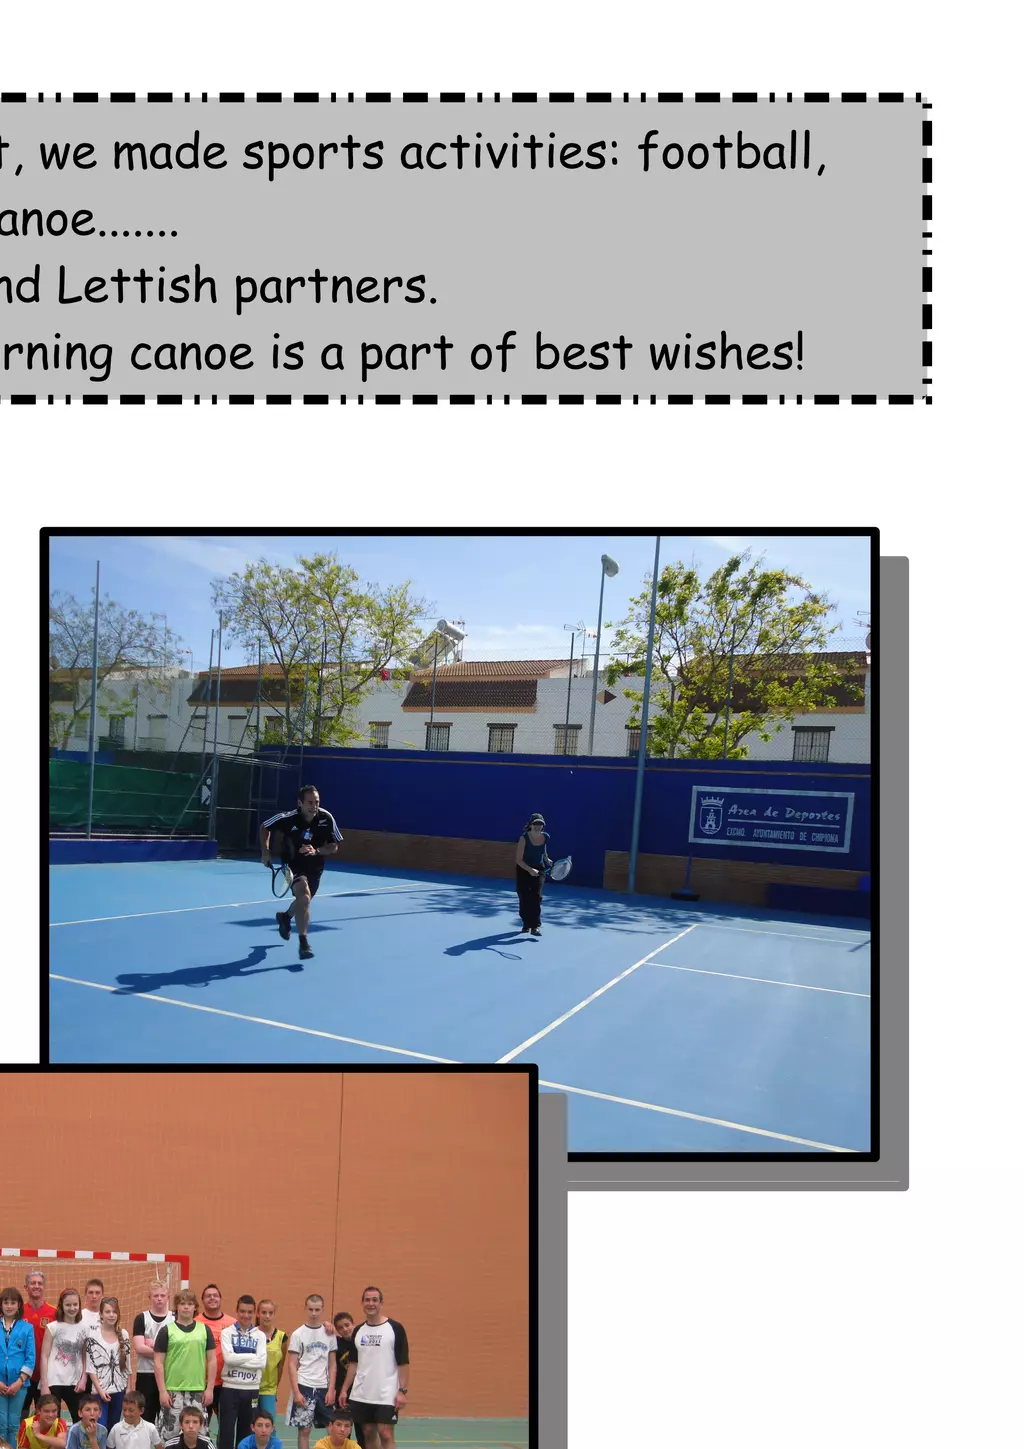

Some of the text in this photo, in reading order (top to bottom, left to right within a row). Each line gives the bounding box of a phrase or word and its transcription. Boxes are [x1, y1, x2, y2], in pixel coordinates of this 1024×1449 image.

[728, 804, 841, 822] Area de Deportes
[752, 828, 795, 840] AYUNTAMIENTO
[799, 832, 807, 841] DE
[811, 833, 839, 843] CHIPIONA
